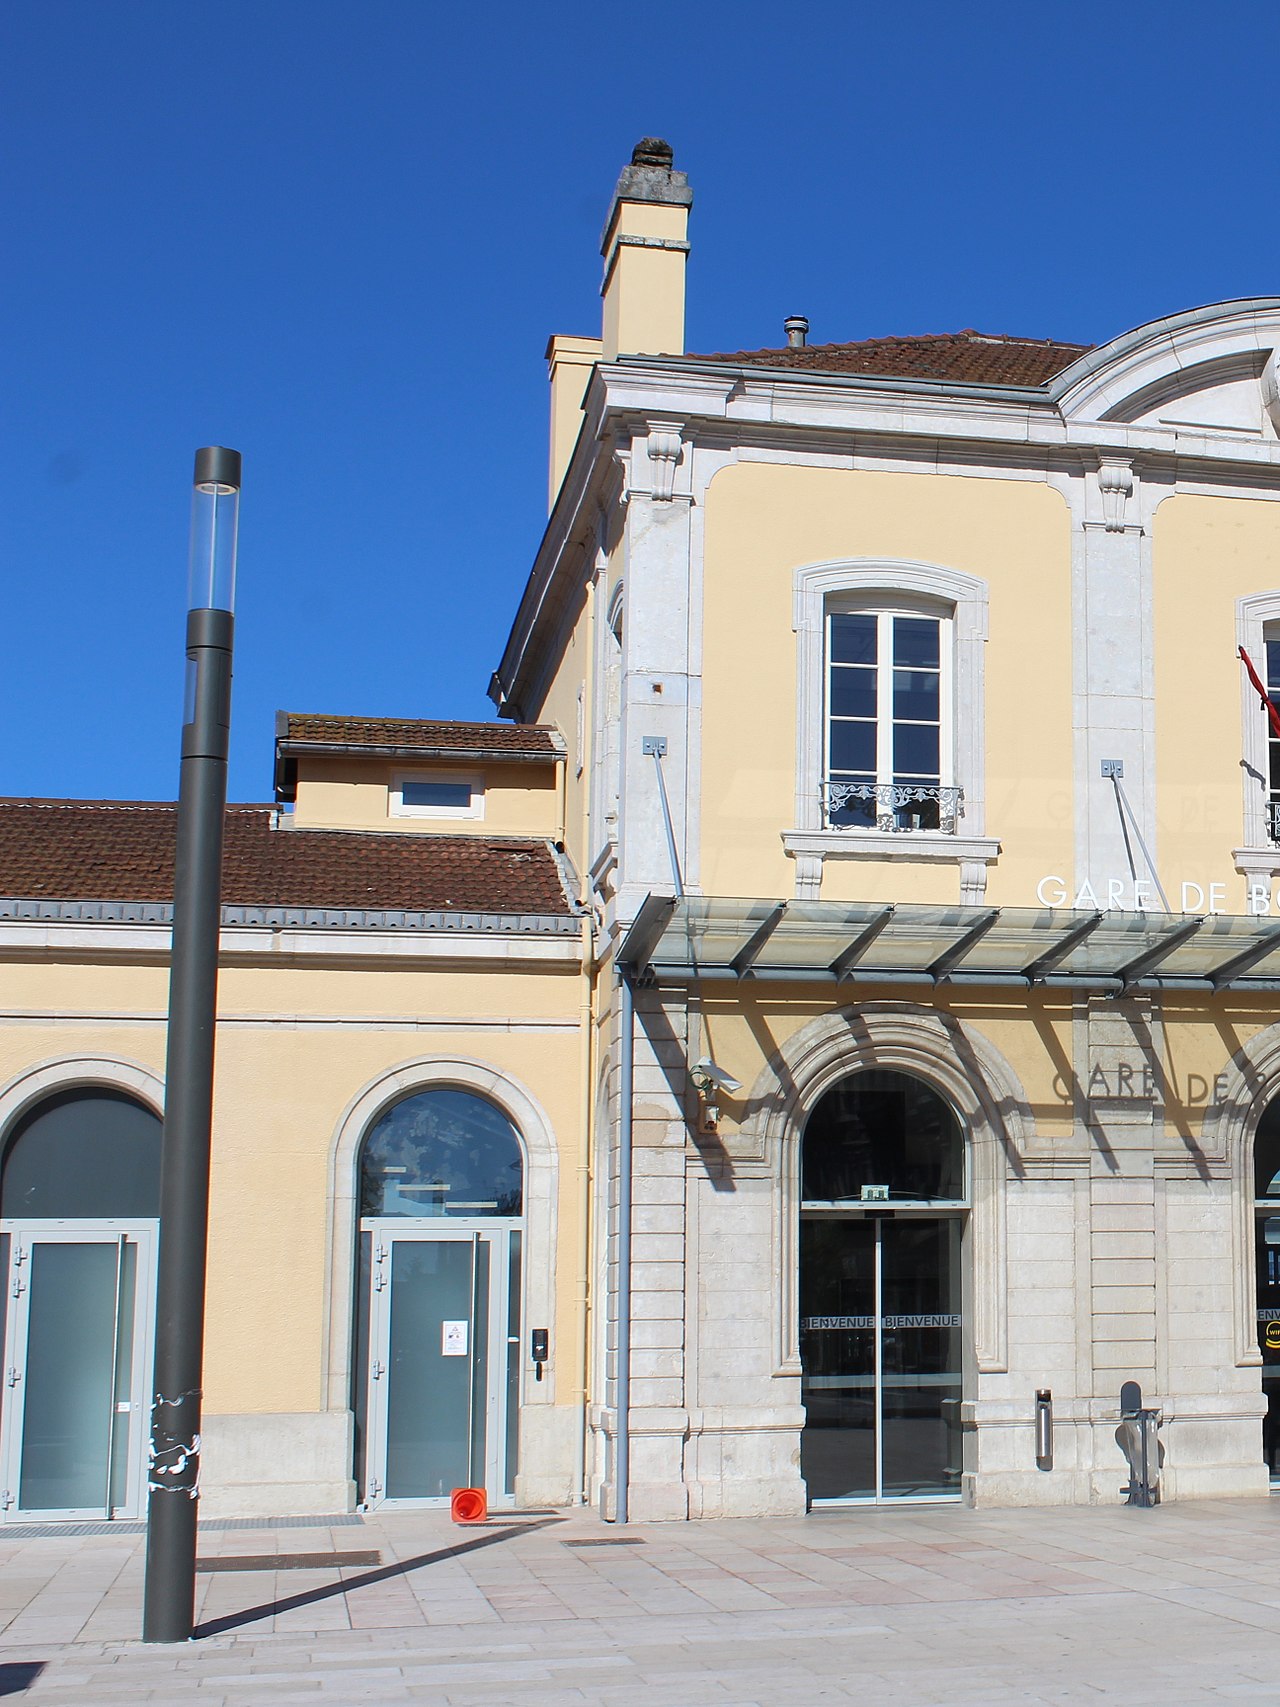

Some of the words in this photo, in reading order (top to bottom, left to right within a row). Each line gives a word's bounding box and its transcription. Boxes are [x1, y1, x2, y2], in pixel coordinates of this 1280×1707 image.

[1036, 876, 1151, 911] GARE
[1181, 881, 1227, 914] DE
[800, 1317, 874, 1328] BIENVENUE
[885, 1315, 959, 1327] BIENVENUE
